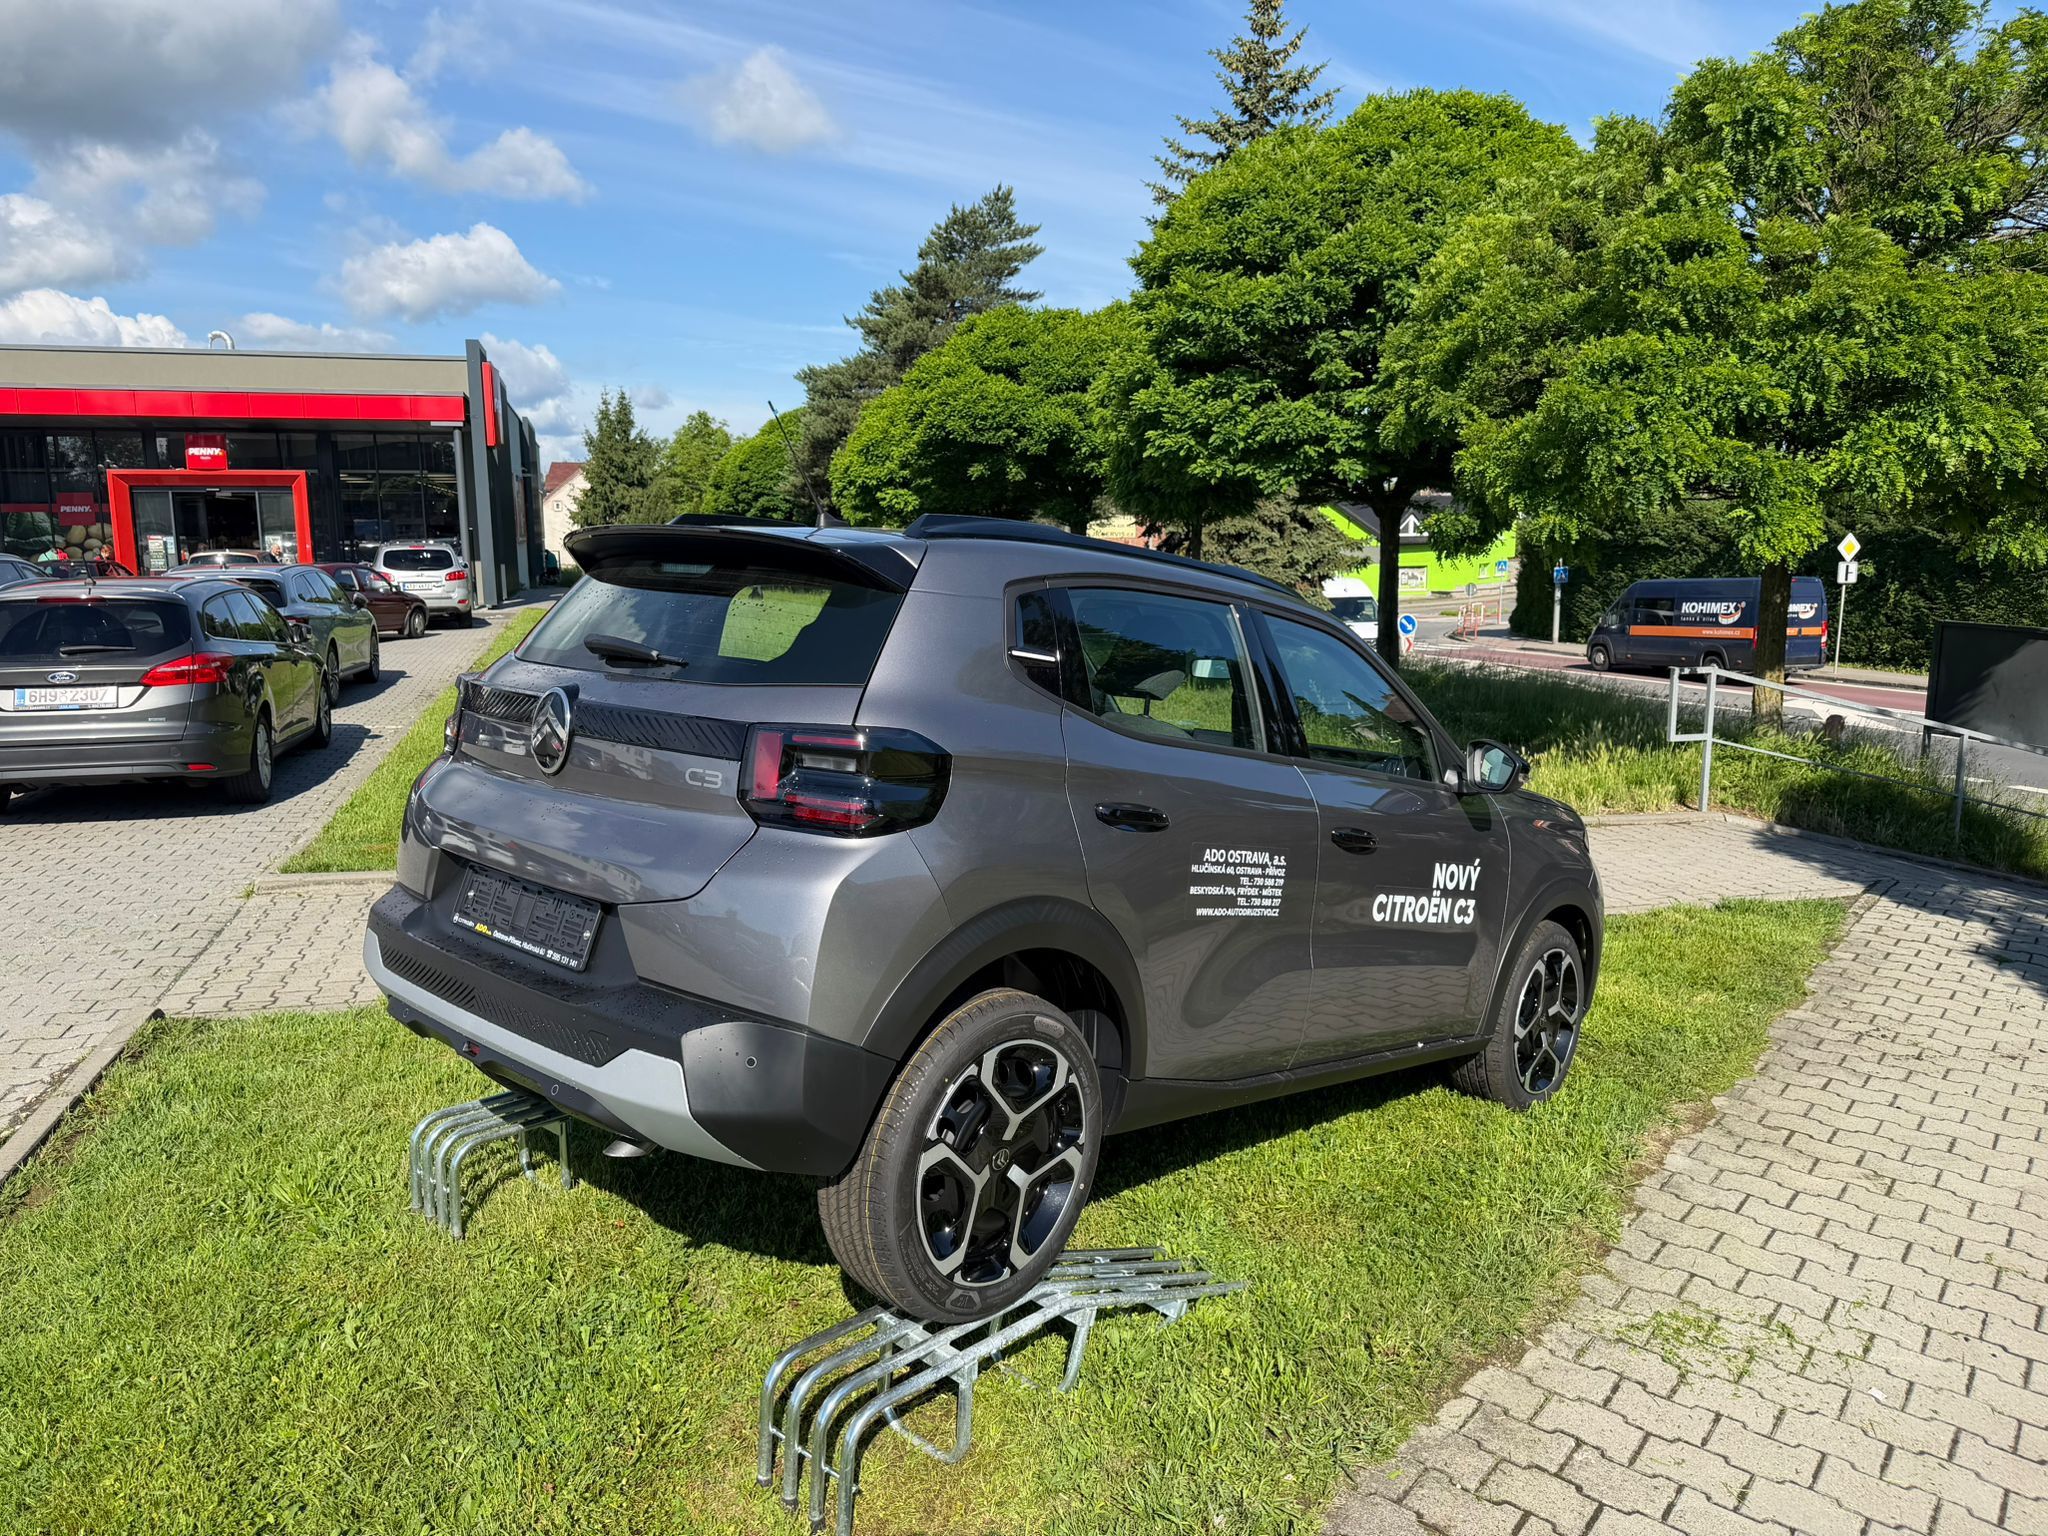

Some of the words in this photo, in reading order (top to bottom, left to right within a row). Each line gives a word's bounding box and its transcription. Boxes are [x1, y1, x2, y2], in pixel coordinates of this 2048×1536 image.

[188, 447, 224, 456] PENNY.
[60, 505, 92, 513] PENNY.
[1681, 602, 1737, 614] KOHIMEX
[29, 689, 58, 703] 6H9
[70, 688, 109, 702] 2307
[685, 767, 722, 789] C3
[1203, 848, 1226, 862] ADO
[1227, 850, 1272, 867] OSTRAVA,
[1273, 855, 1286, 866] a.s.
[1191, 862, 1226, 874] HLUČÍNSKÁ
[1226, 865, 1235, 875] 60,
[1236, 866, 1262, 875] OSTRAVA
[1432, 858, 1481, 891] NOVÝ
[1190, 885, 1224, 895] BESKYDSKÁ
[1237, 886, 1259, 896] FRÝDEK
[1262, 887, 1282, 897] MÍSTEK
[1372, 890, 1452, 923] CITROËN
[1453, 898, 1476, 924] C3
[474, 922, 487, 932] ADO
